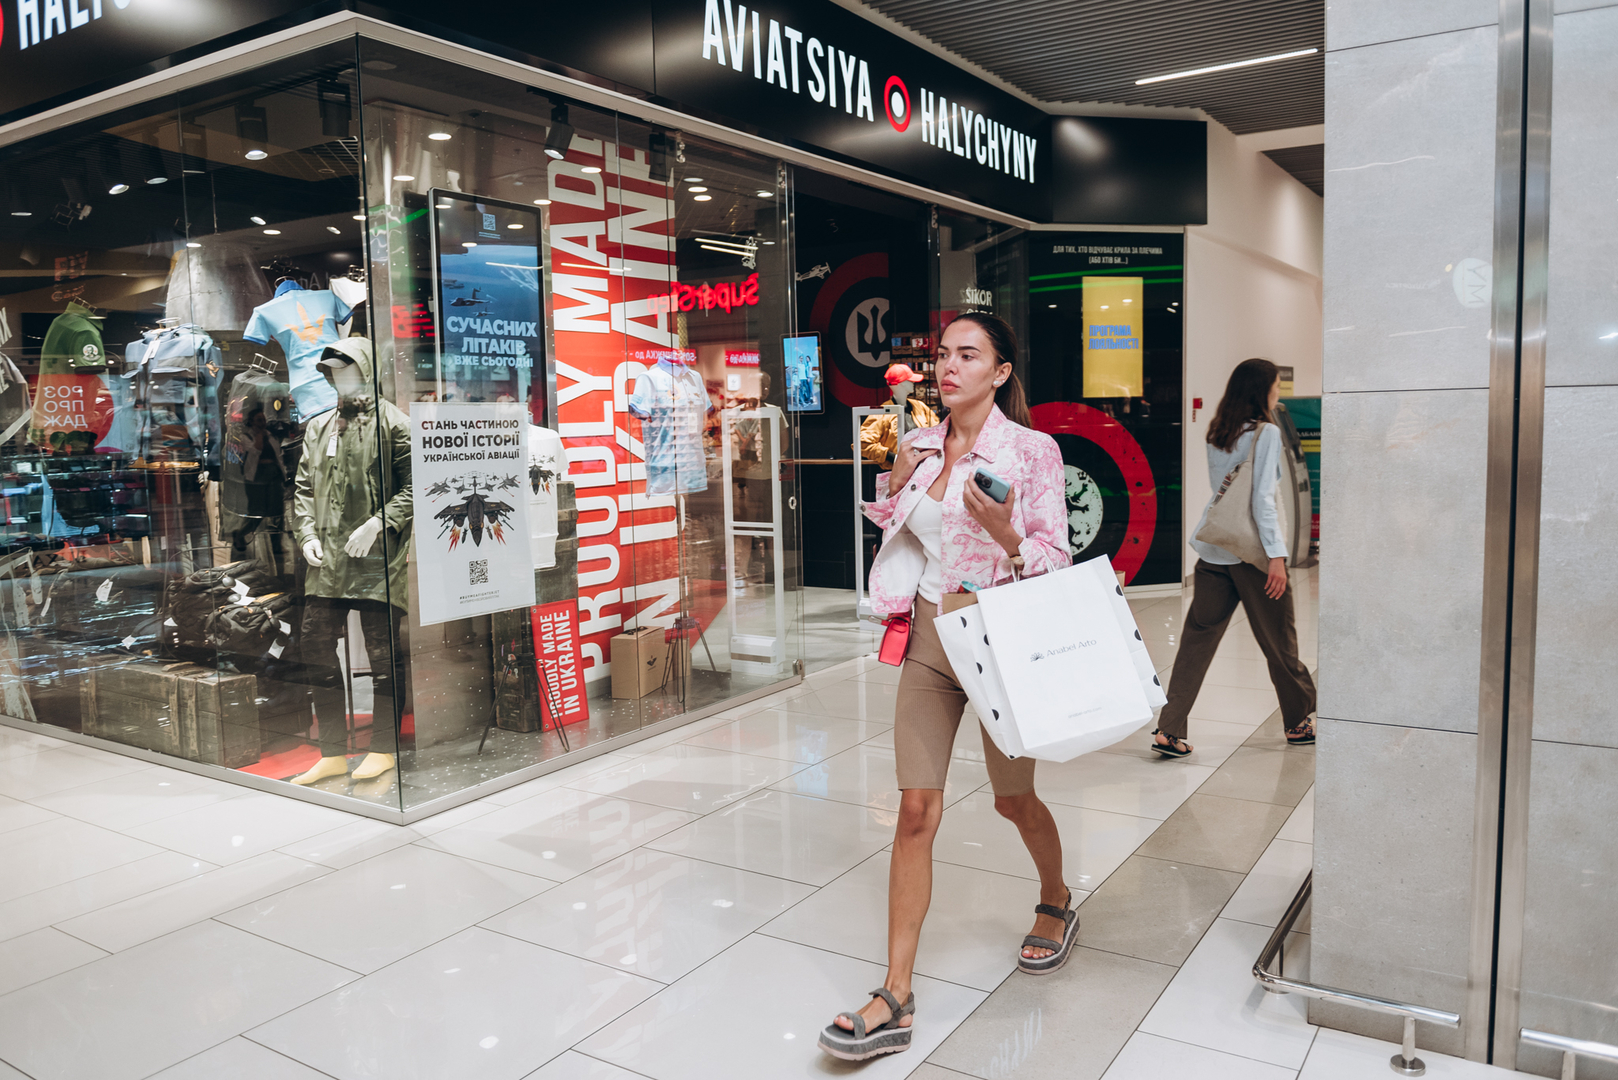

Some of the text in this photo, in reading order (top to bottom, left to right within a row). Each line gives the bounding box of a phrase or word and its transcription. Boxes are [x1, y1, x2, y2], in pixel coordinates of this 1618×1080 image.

[702, 0, 1037, 184] AVIATSIYA HALYCHYNY
[1078, 245, 1088, 254] ХТО
[446, 316, 538, 338] СУЧАСНИХ
[1089, 325, 1132, 336] ПРОГРАМА
[461, 337, 527, 355] ЛІТАКІВ
[1088, 338, 1139, 350] ЛОЯЛЬНОСТІ
[454, 355, 534, 368] ВЖЕ СЬОГОДНІ
[421, 419, 519, 430] СТАНЬ ЧАСТИНОЮ
[422, 430, 520, 449] НОВОЇ ІСТОРІЇ
[423, 449, 520, 463] УКРАЇНСЬКОЇ АВІАЦІЇ
[555, 358, 623, 684] PROUDLY
[540, 613, 556, 654] MADE
[1047, 639, 1097, 656] Anabel Arto
[553, 610, 580, 715] IN UKRAINE
